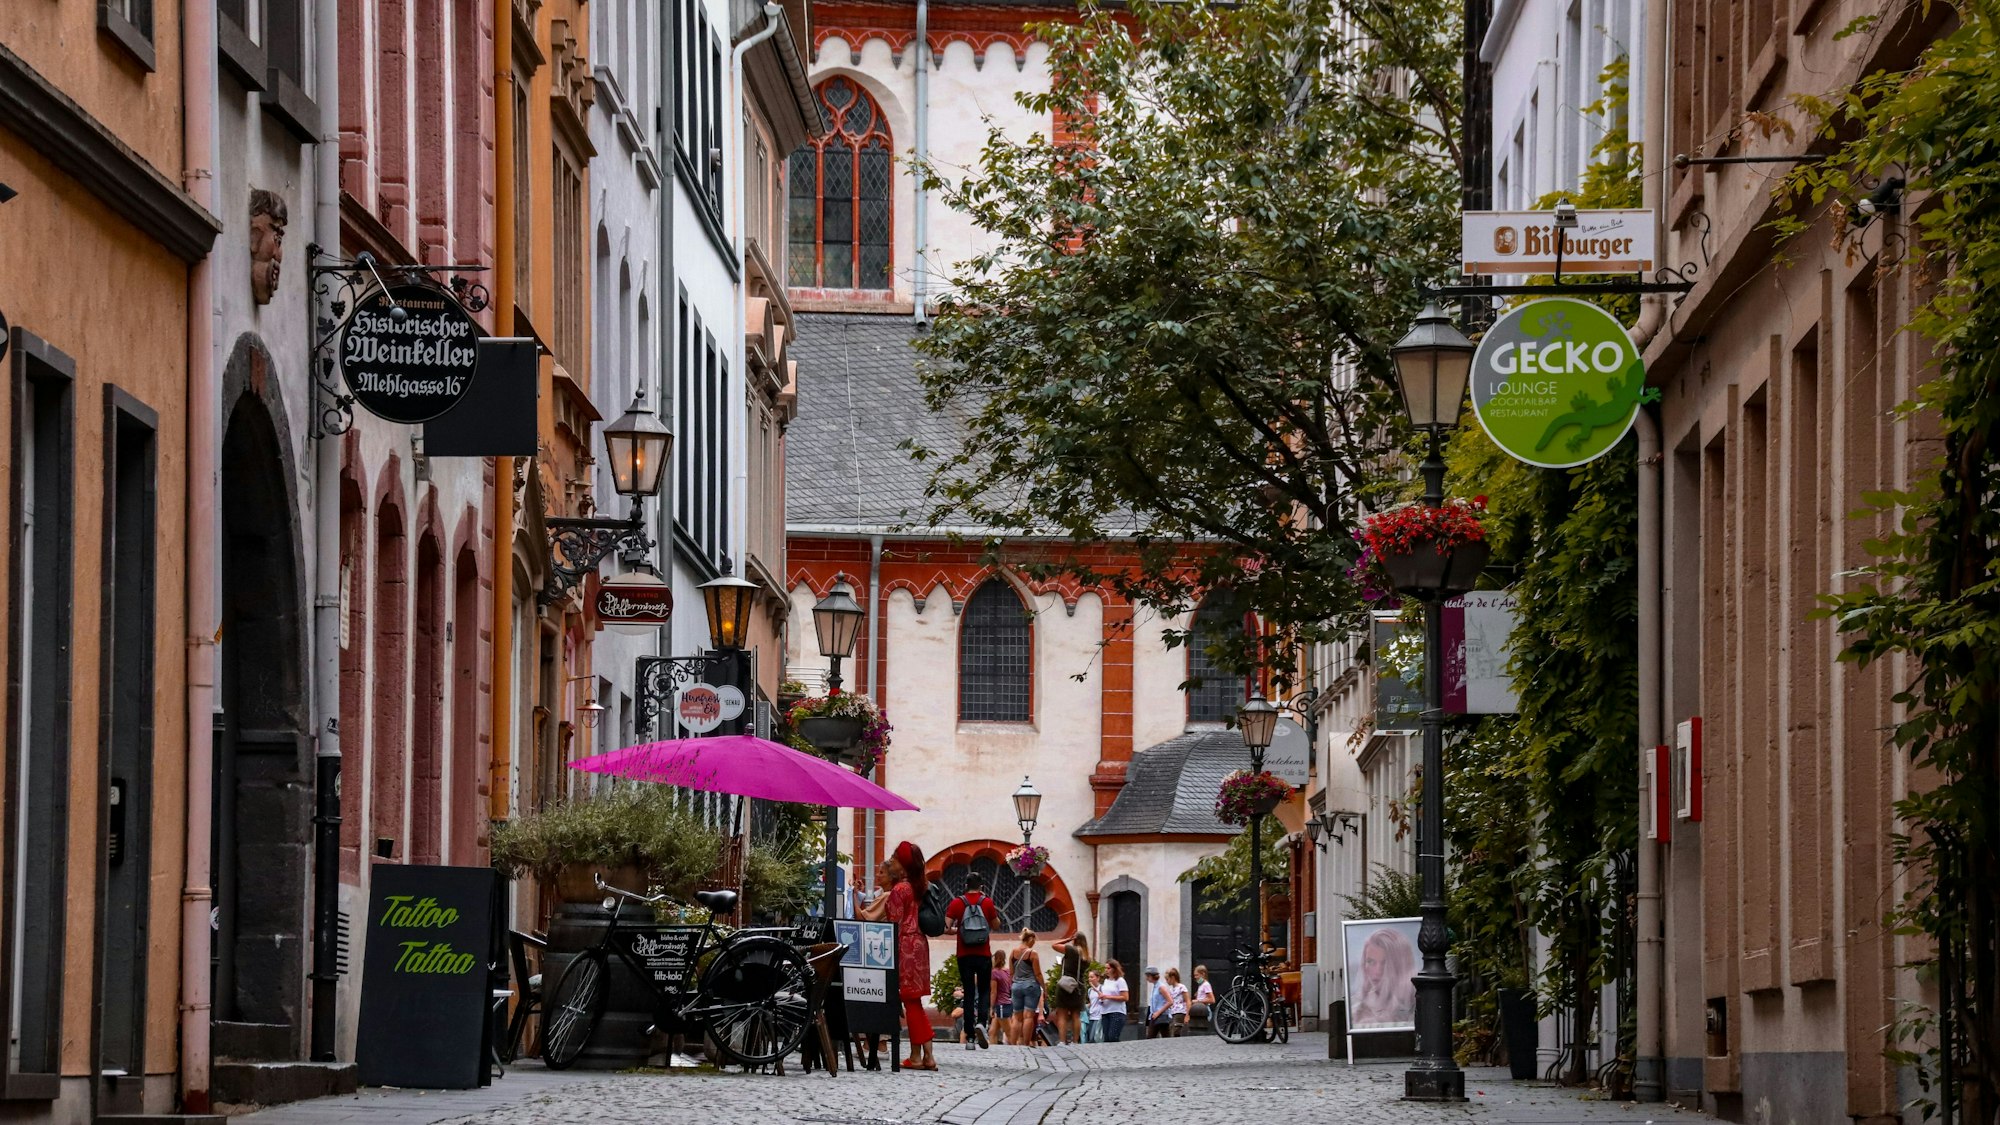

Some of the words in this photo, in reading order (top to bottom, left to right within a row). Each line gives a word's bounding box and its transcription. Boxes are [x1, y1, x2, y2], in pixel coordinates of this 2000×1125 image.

[1523, 225, 1633, 260] Bitburger
[379, 297, 445, 310] Rstaurant
[350, 310, 469, 339] Historischer
[344, 336, 475, 367] Weinkeller
[1490, 341, 1624, 374] GECKO
[1490, 381, 1557, 395] LOUNGE
[1490, 398, 1557, 406] COCKTAILBAR
[1490, 409, 1548, 418] RESTAURANT
[1477, 597, 1488, 608] de
[380, 895, 459, 928] Tattoo
[660, 933, 673, 941] bistro
[654, 970, 683, 980] fritz-kola
[846, 987, 884, 996] EINGANG
